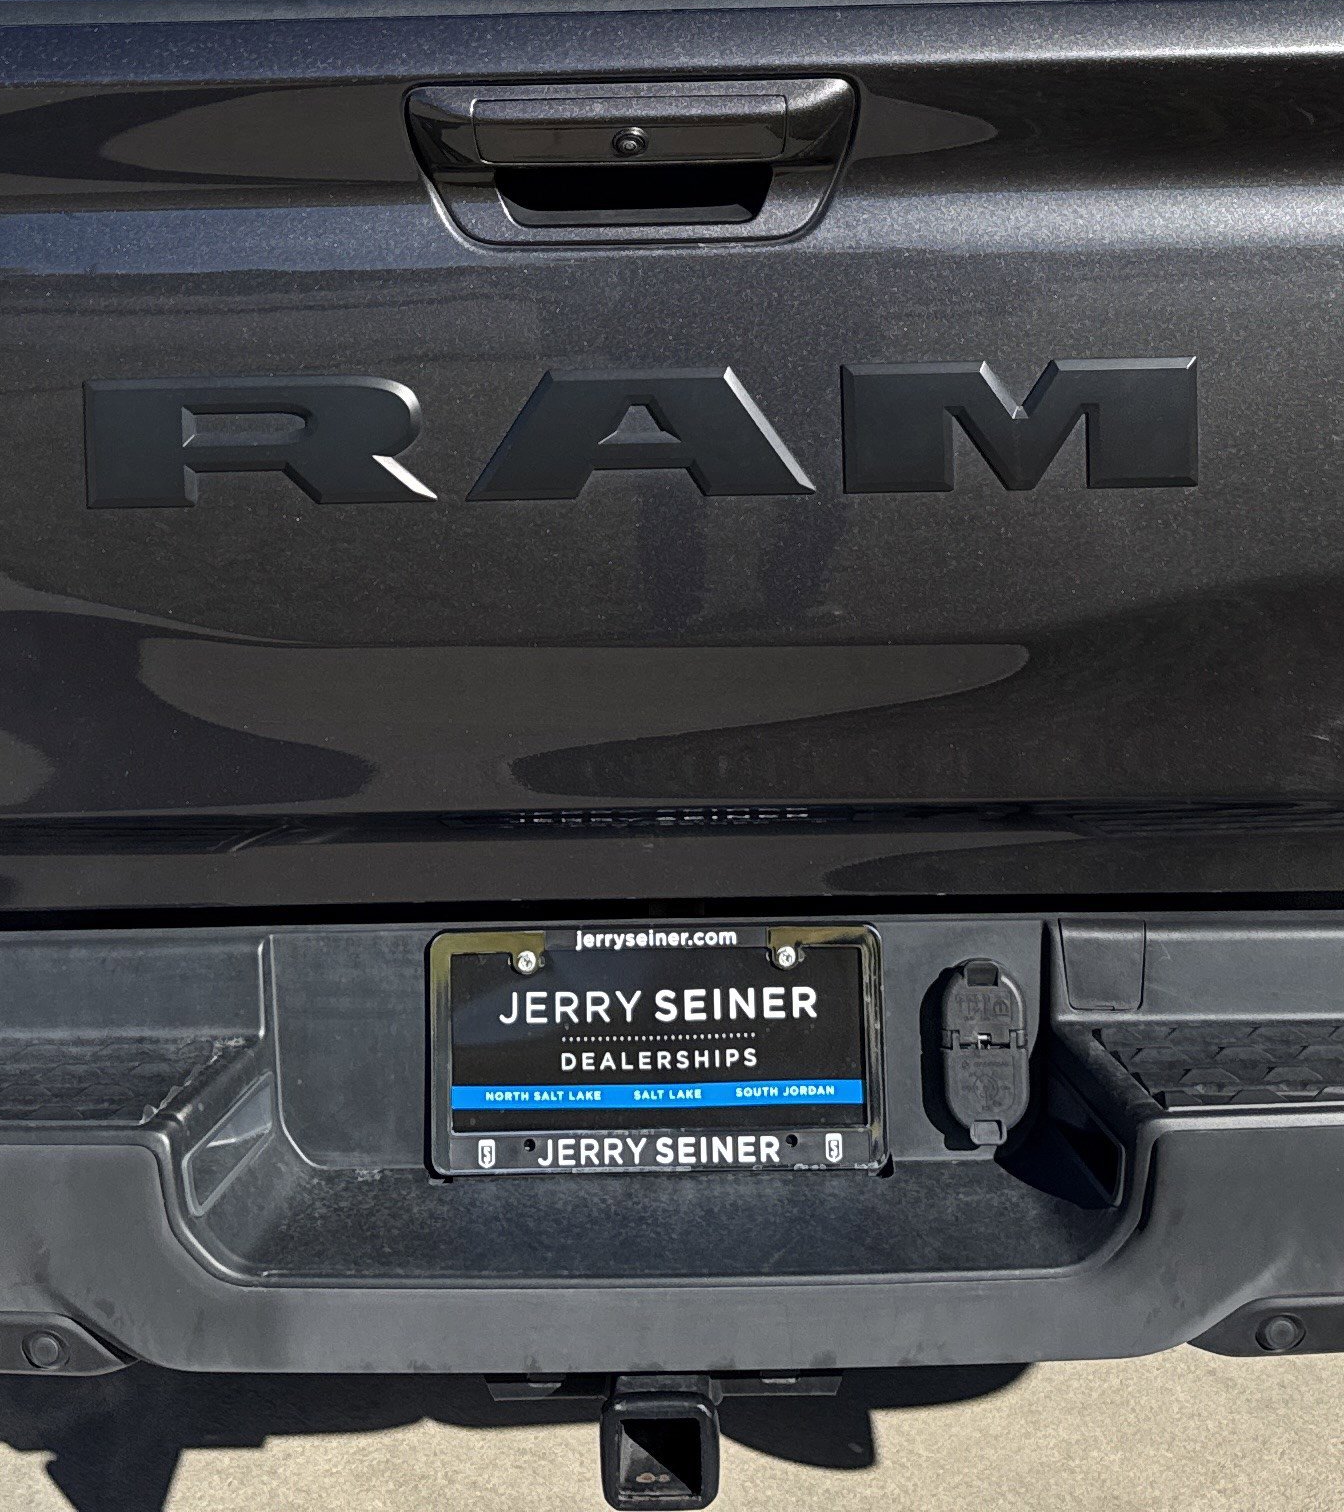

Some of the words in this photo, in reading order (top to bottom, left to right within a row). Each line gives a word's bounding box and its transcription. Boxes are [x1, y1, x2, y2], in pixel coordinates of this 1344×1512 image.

[83, 355, 1199, 509] RAM
[575, 929, 737, 951] jerryseiner.com
[499, 990, 642, 1025] JERRY
[654, 986, 818, 1023] SEINER
[560, 1048, 758, 1072] DEALERSHIPS
[485, 1091, 529, 1102] NORTH
[533, 1091, 564, 1101] SALT
[568, 1090, 602, 1101] LAKE
[633, 1090, 665, 1100] SALT
[668, 1088, 702, 1100] LAKE
[735, 1086, 778, 1098] SOUTH
[782, 1085, 835, 1097] JORDAN
[537, 1138, 647, 1167] JERRY
[655, 1135, 781, 1164] SEINER
